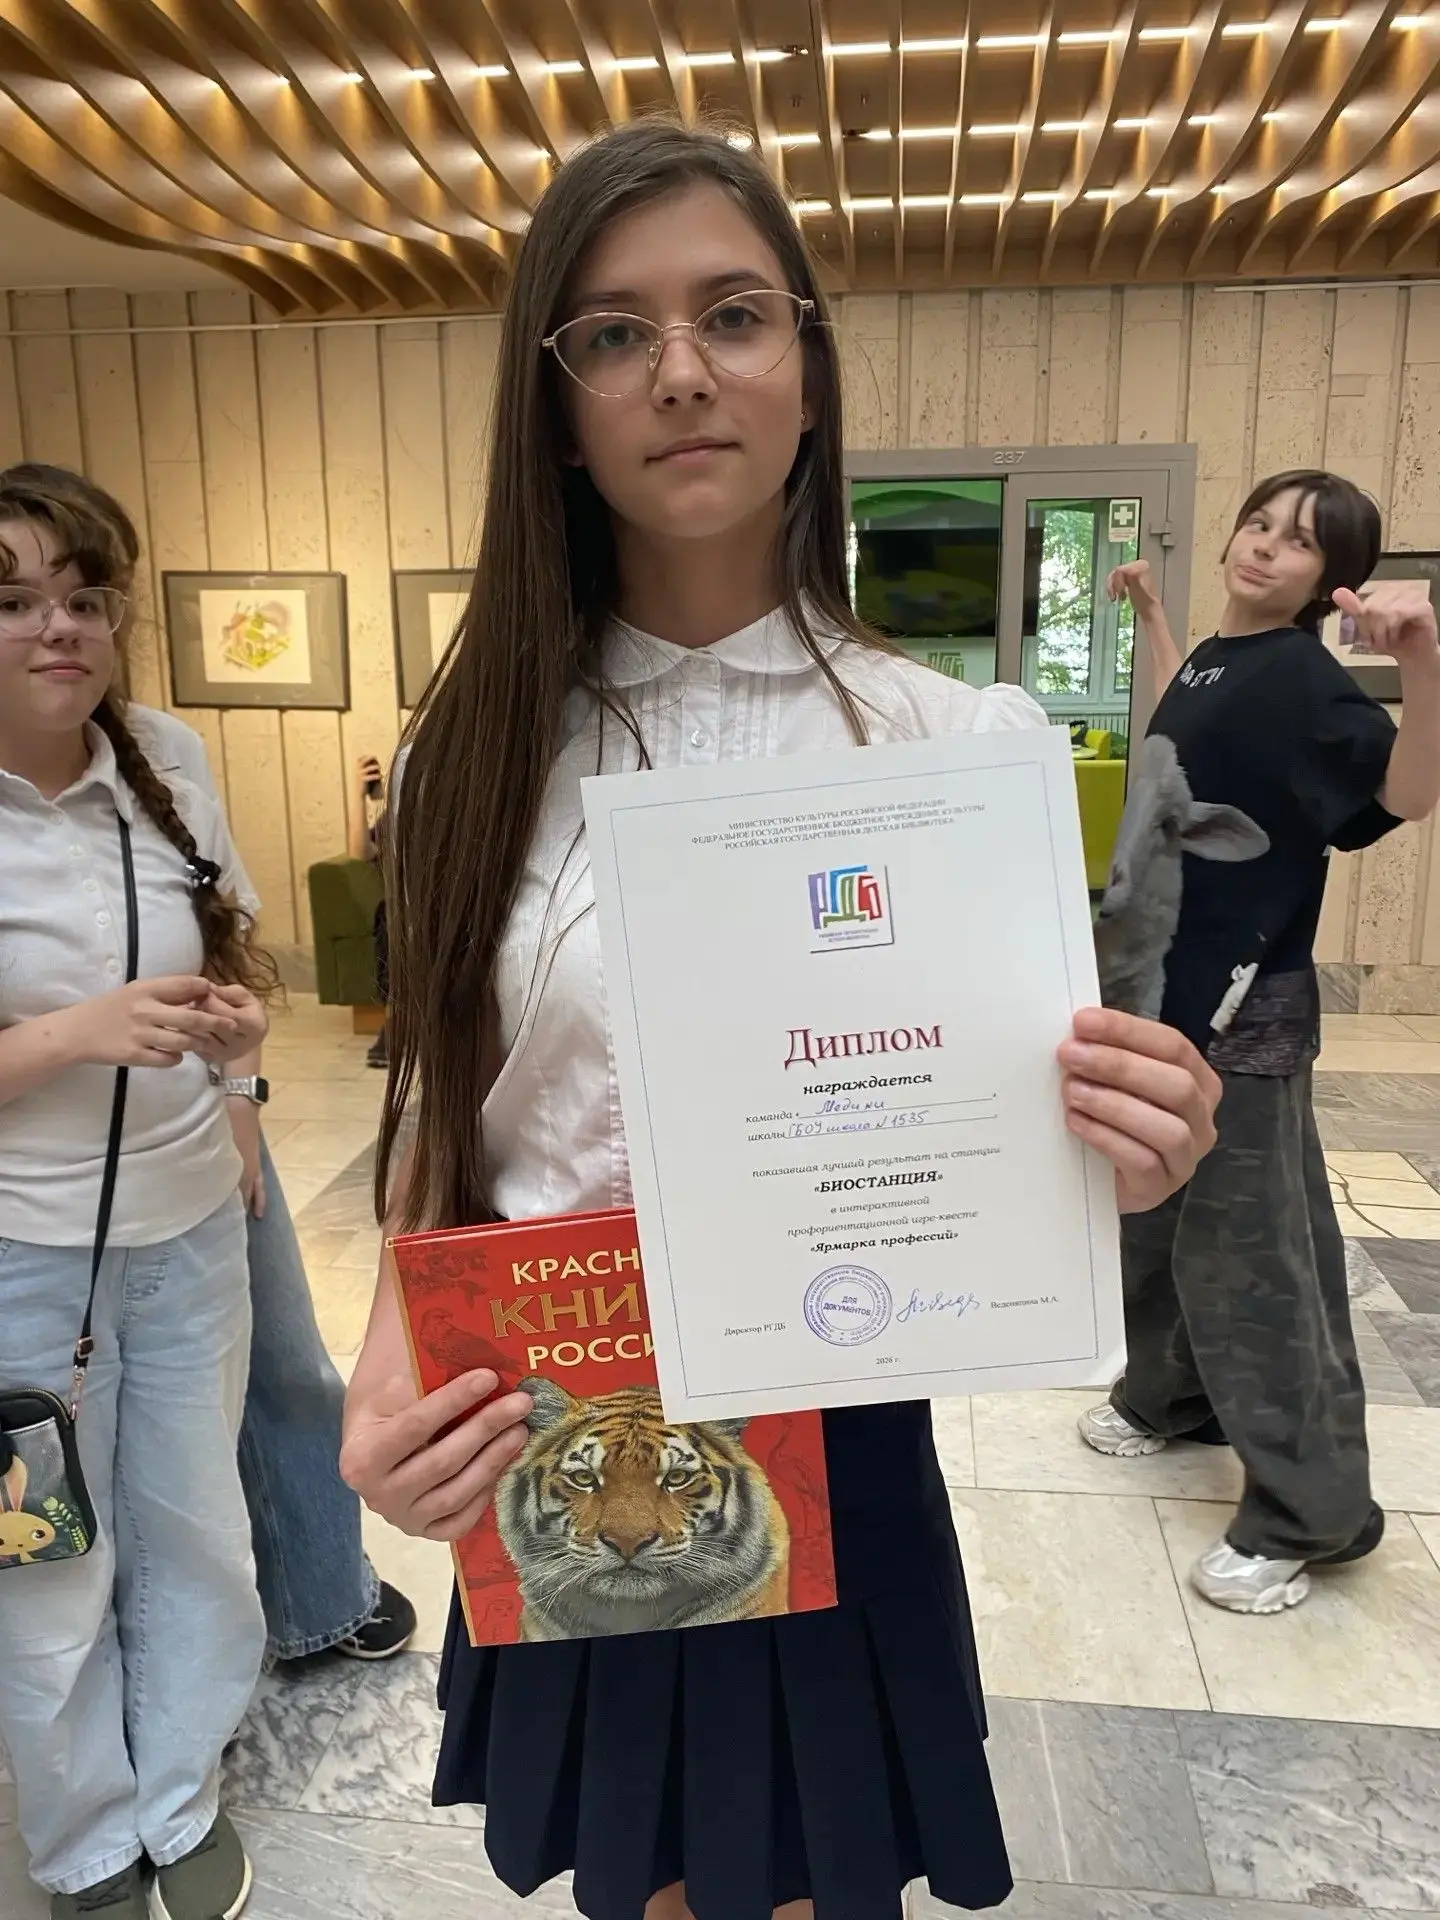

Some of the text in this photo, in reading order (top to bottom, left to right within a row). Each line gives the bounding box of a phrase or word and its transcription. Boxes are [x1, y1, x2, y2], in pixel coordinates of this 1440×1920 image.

[993, 450, 1025, 464] 237
[728, 799, 946, 830] МИНИСТЕРСТВО КУЛЬТУРЫ РОССИЙСКОЙ ФЕДЕРАЦИИ
[691, 832, 749, 844] ФЕДЕРАЛЬНОЕ
[751, 823, 830, 839] ГОСУДАРСТВЕННОЕ
[832, 816, 885, 828] БЮДЖЕТНОЕ
[725, 838, 778, 850] РОССИЙСКАЯ
[780, 828, 861, 843] ГОСУДАРСТВЕННАЯ
[862, 824, 900, 835] ДЕТСКАЯ
[803, 1073, 932, 1095] награждается
[746, 1111, 792, 1123] команда
[890, 1110, 929, 1128] 1535
[748, 1131, 785, 1141] школы
[752, 1147, 1001, 1178] показавшая лучший результат на станции
[814, 1170, 943, 1192] «БИОСТАНЦИЯ»
[839, 1197, 930, 1214] интерактивной
[788, 1210, 979, 1237] профориентационной игре-квесте
[810, 1229, 959, 1254] «Ярмарка профессий»
[823, 1302, 872, 1316] ДОКУМЕНТОВ
[842, 1296, 857, 1304] ДЛЯ
[724, 1322, 787, 1336] Директор РГДБ
